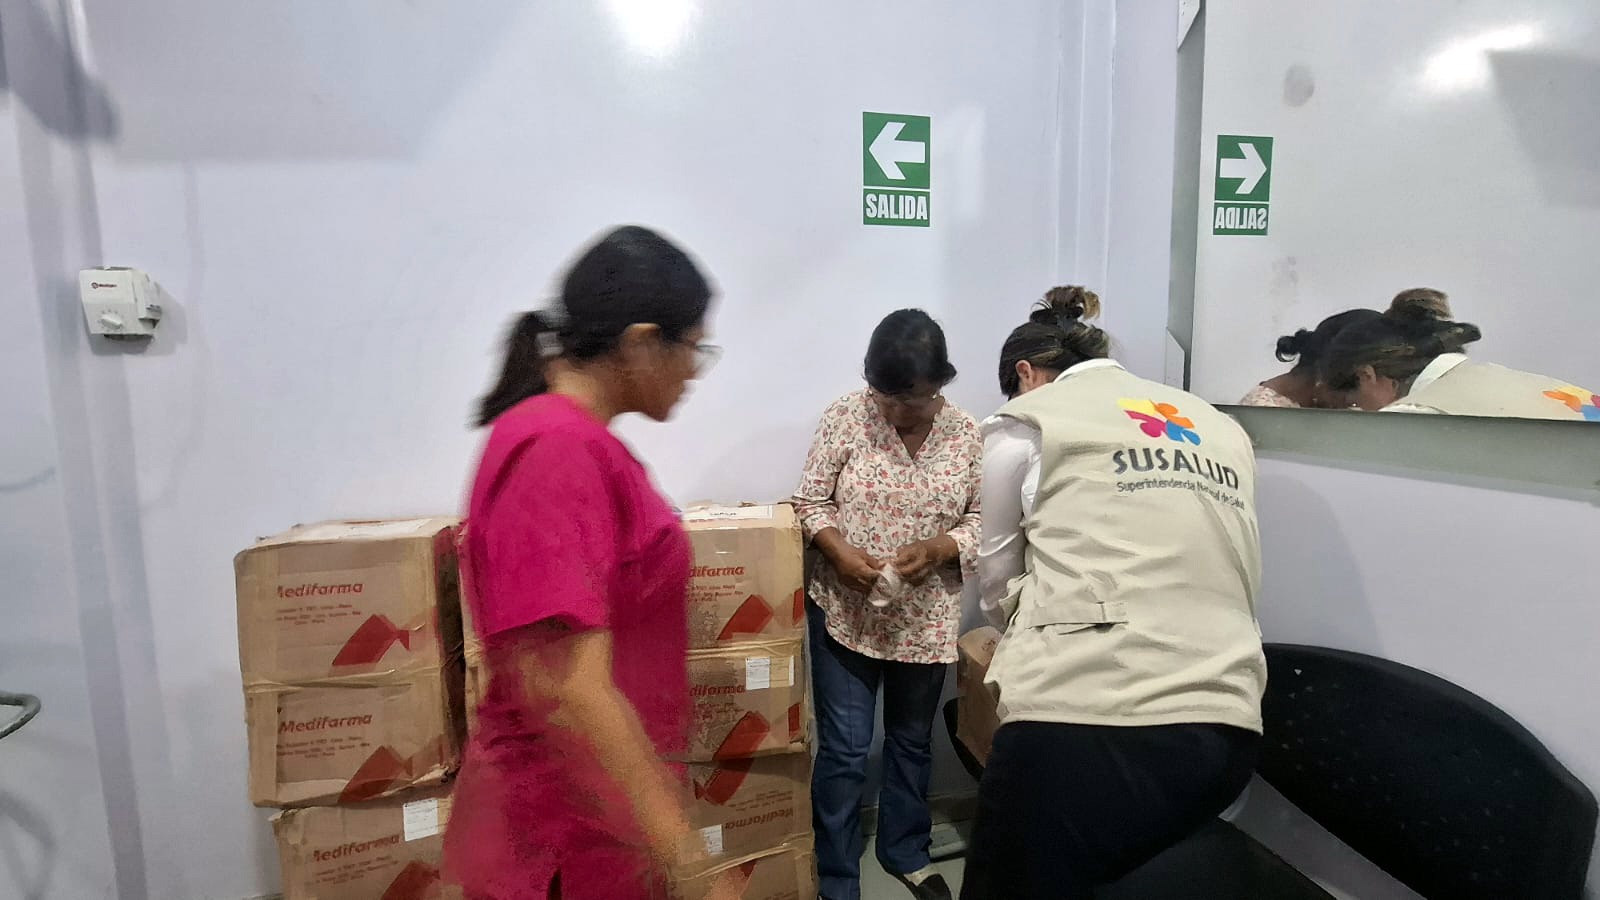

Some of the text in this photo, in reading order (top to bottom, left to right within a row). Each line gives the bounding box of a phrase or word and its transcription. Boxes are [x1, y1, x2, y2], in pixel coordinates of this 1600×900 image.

[866, 193, 928, 220] SALIDA
[1112, 448, 1239, 490] SUSALUD
[688, 566, 745, 578] difarma
[690, 684, 746, 697] difarma
[280, 714, 372, 733] Medifarma
